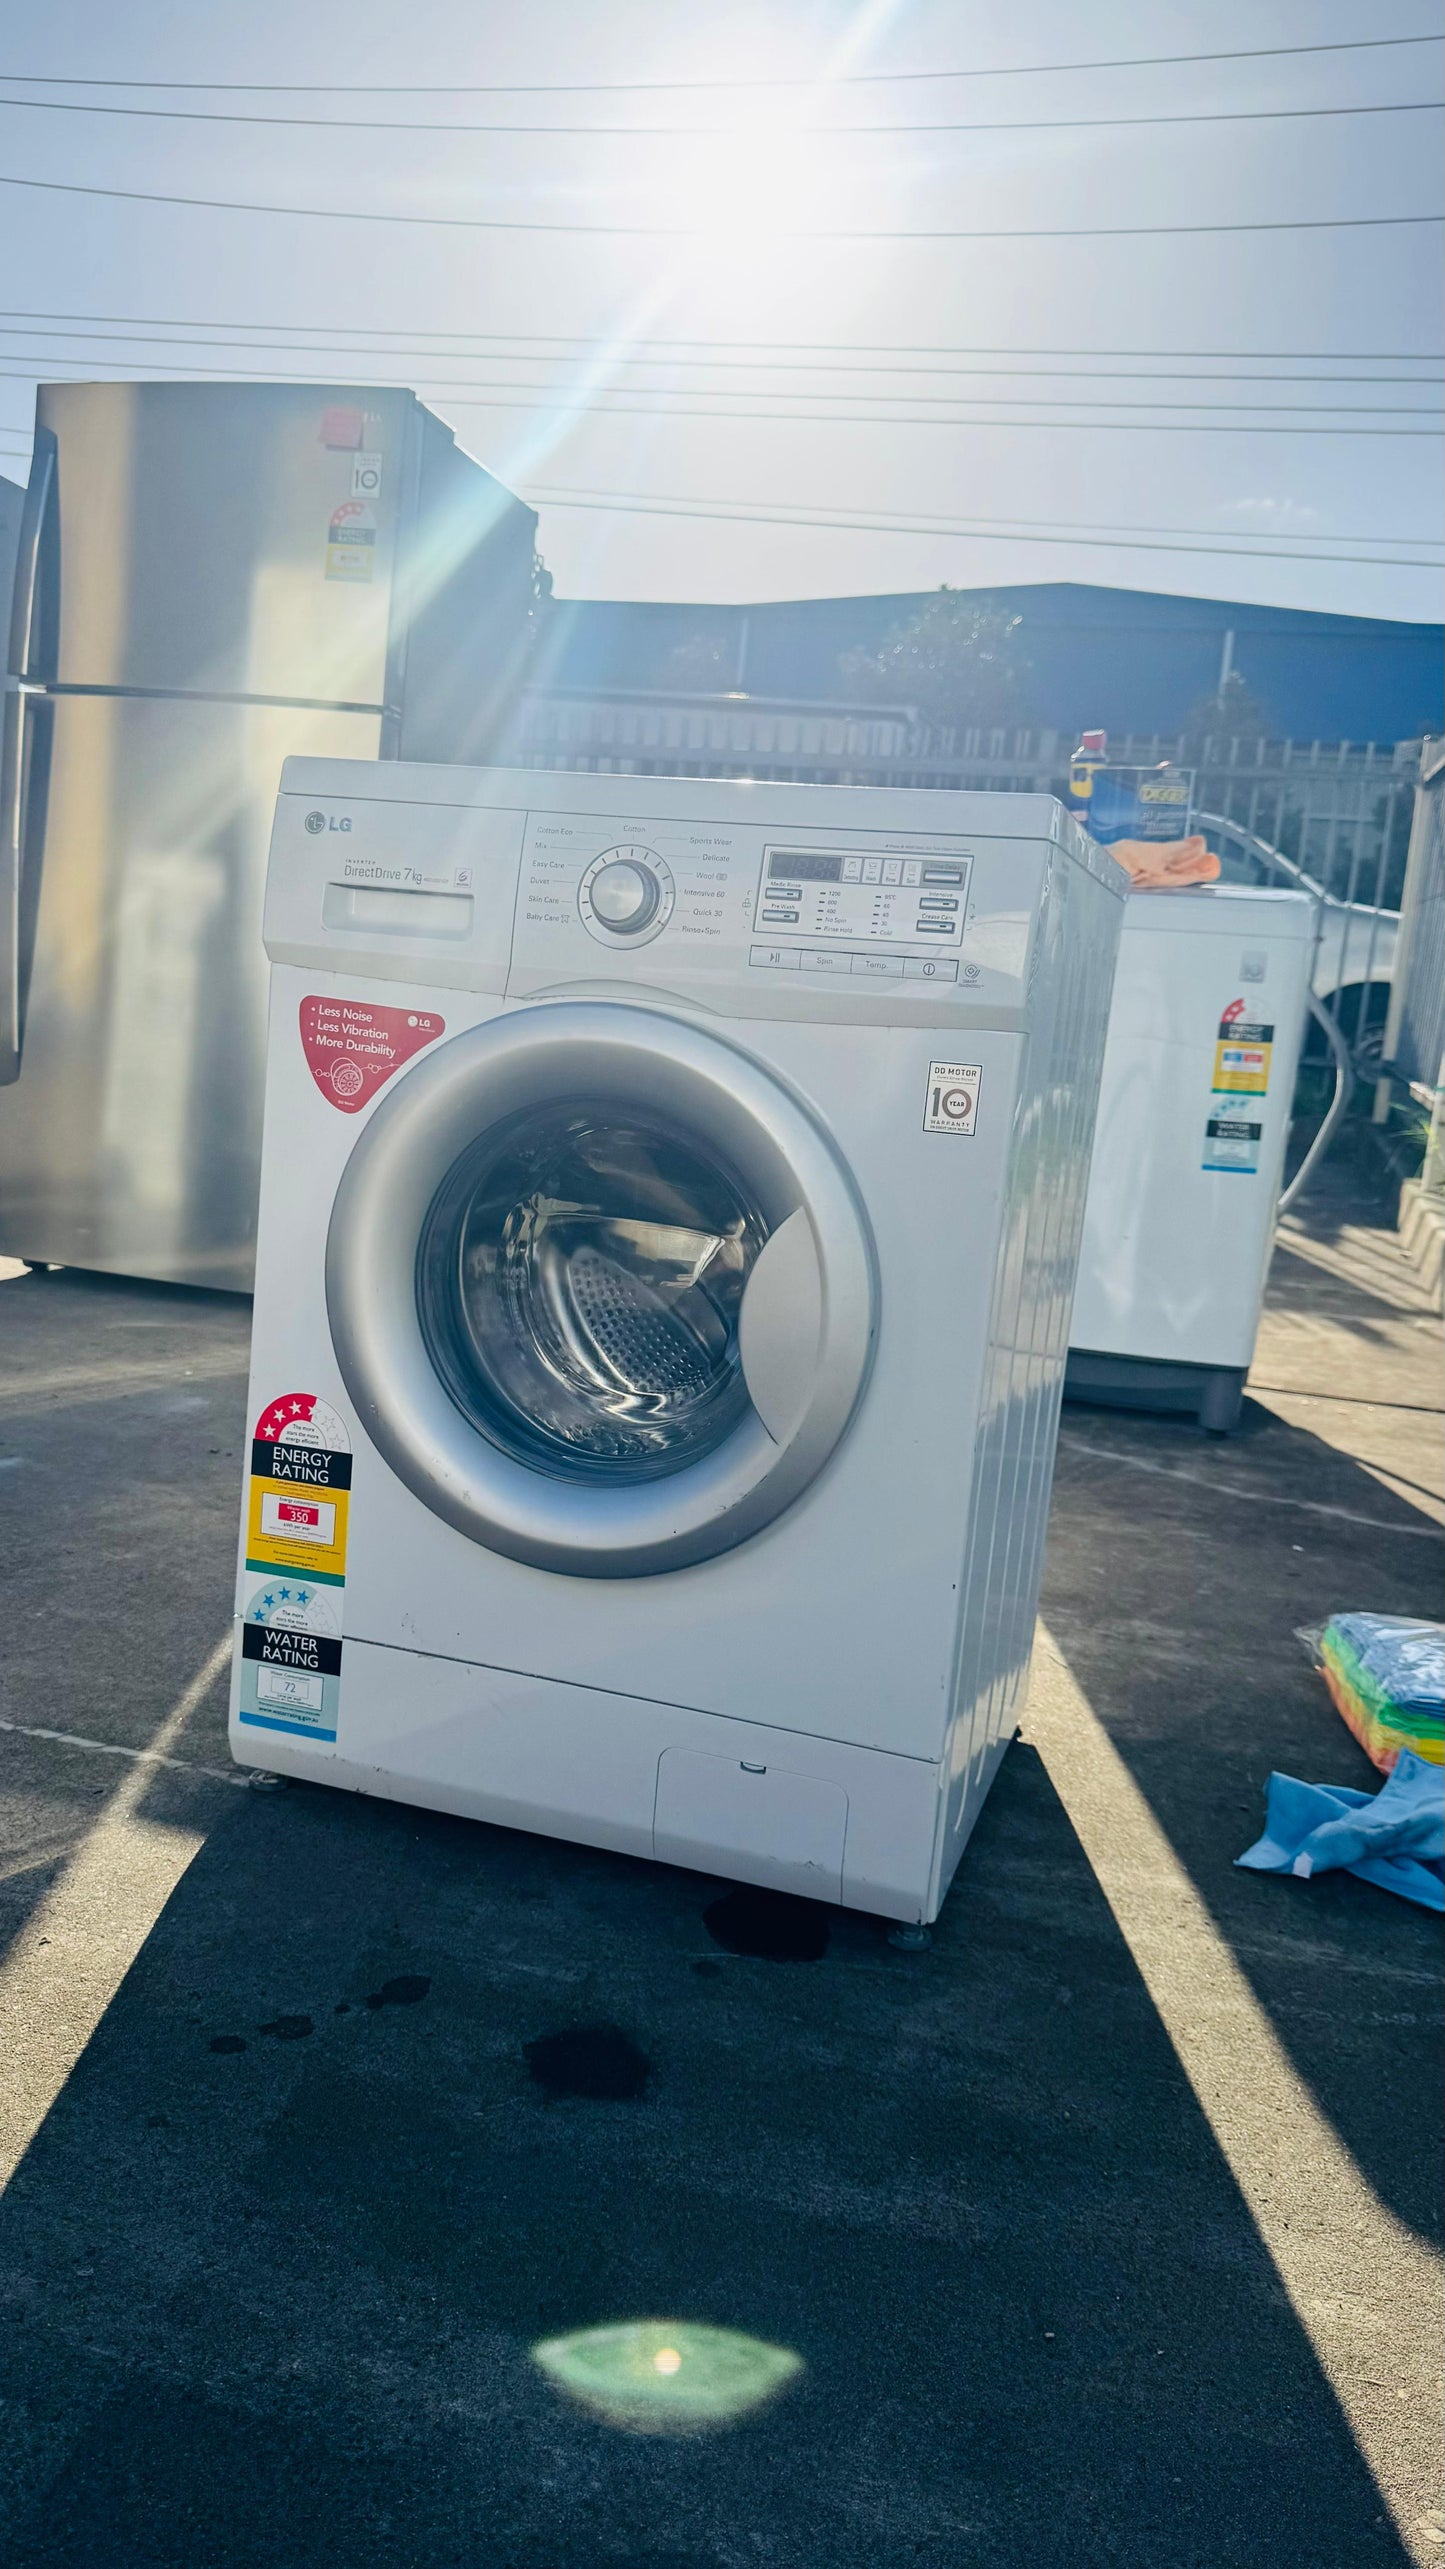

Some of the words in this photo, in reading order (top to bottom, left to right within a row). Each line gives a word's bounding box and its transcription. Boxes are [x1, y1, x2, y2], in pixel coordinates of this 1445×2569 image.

[329, 817, 352, 832] LG
[623, 825, 646, 833] Cotton
[537, 826, 559, 835] Cotton
[560, 828, 573, 836] Eco
[689, 837, 712, 845] Sports
[714, 838, 732, 846] Wear
[702, 854, 730, 862] Delicate
[532, 860, 548, 869] Easy
[549, 861, 564, 869] Care
[344, 865, 402, 880] DirectDrive
[404, 867, 422, 885] 7kg
[696, 872, 714, 880] Wool
[684, 889, 714, 898] Intensive
[528, 895, 543, 904] Skin
[544, 896, 559, 904] Care
[526, 912, 543, 922] Baby
[544, 913, 559, 922] Care
[693, 908, 712, 916] Quick
[714, 909, 722, 917] 30
[816, 956, 833, 966] Spin
[865, 960, 889, 970] Temp.
[319, 1005, 341, 1018] Less
[343, 1008, 373, 1022] Noise
[418, 1019, 431, 1028] LG
[317, 1020, 339, 1033] Less
[342, 1023, 389, 1040] Vibration
[316, 1035, 344, 1048] More
[346, 1039, 396, 1058] Durability
[934, 1066, 946, 1075] DD
[948, 1067, 977, 1077] MOTOR
[932, 1087, 972, 1119] 10
[273, 1446, 332, 1468] ENERGY
[273, 1462, 329, 1483] RATING
[291, 1511, 308, 1523] 350
[265, 1630, 318, 1652] WATER
[263, 1646, 319, 1668] RATING
[284, 1681, 296, 1693] 72
